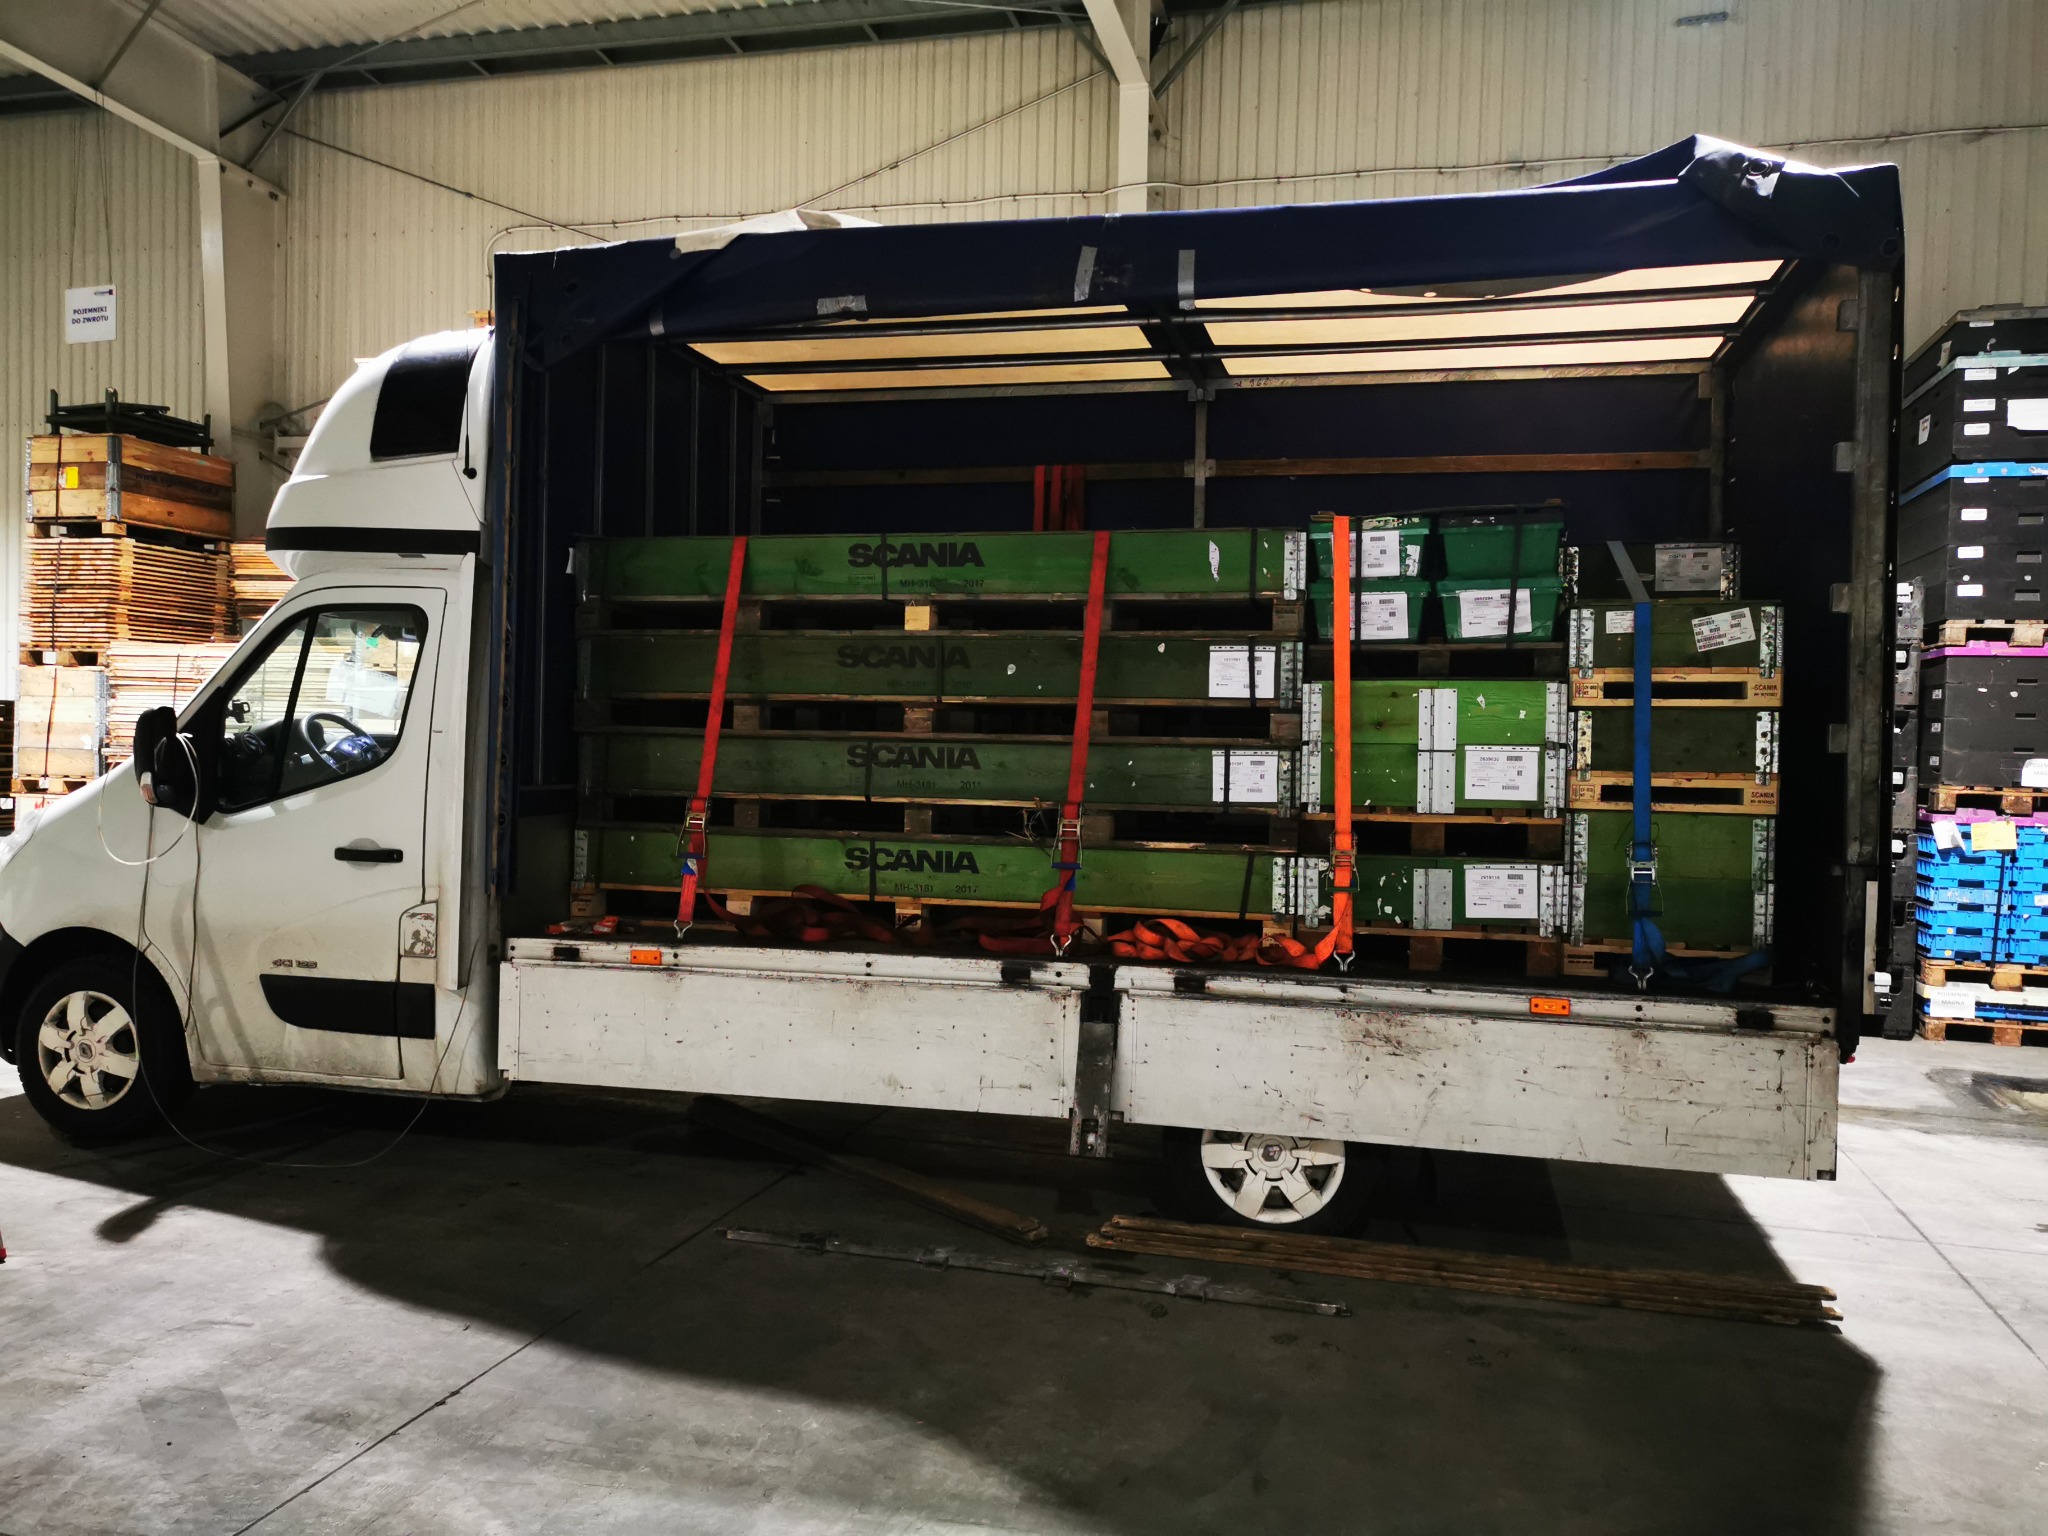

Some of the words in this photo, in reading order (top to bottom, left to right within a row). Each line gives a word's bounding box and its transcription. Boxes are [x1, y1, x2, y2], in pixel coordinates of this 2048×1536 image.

[73, 305, 108, 315] POJEMNIKI
[71, 317, 81, 325] DO
[82, 315, 109, 324] ZWROTU
[848, 542, 985, 568] SCANIA
[837, 645, 972, 669] SCANIA
[847, 744, 982, 770] SCANIA
[1751, 791, 1775, 799] SCANIA
[844, 847, 980, 875] SCANIA
[894, 883, 935, 893] MH-3181
